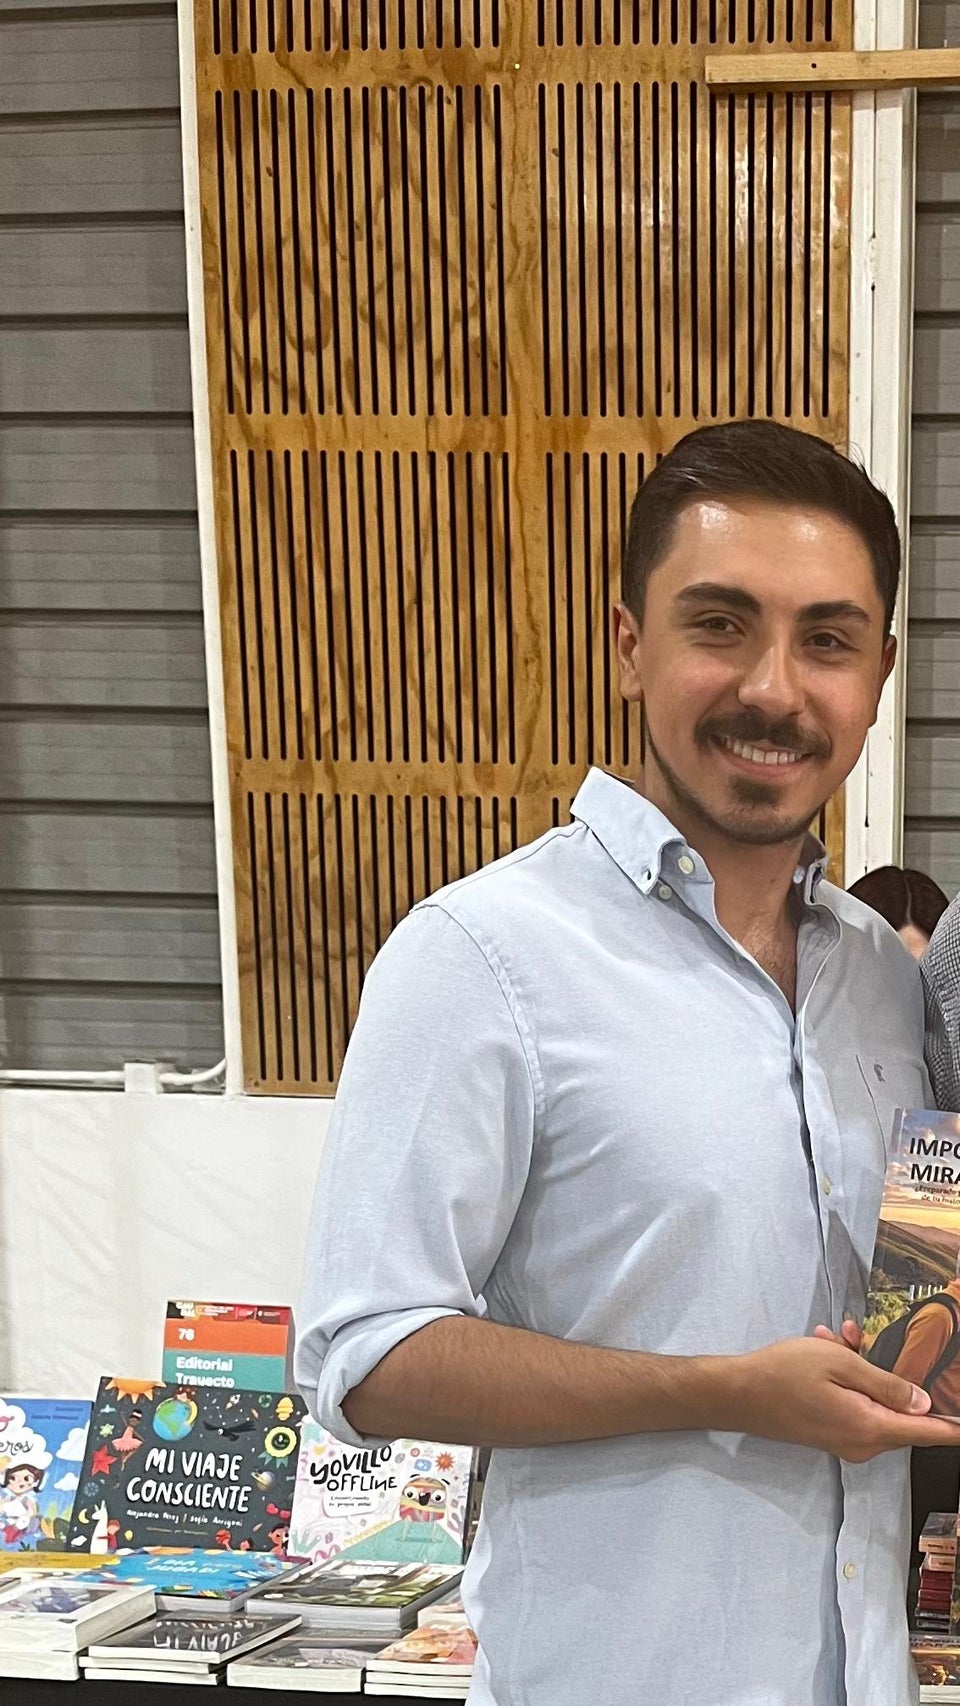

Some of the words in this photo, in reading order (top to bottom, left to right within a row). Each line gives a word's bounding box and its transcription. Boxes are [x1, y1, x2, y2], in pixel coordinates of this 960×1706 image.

[176, 1356, 233, 1371] Editorial
[145, 1447, 175, 1474] MI
[181, 1451, 243, 1481] VIAJE
[126, 1476, 252, 1512] CONSCIENTE
[327, 1473, 398, 1491] OFFLINE
